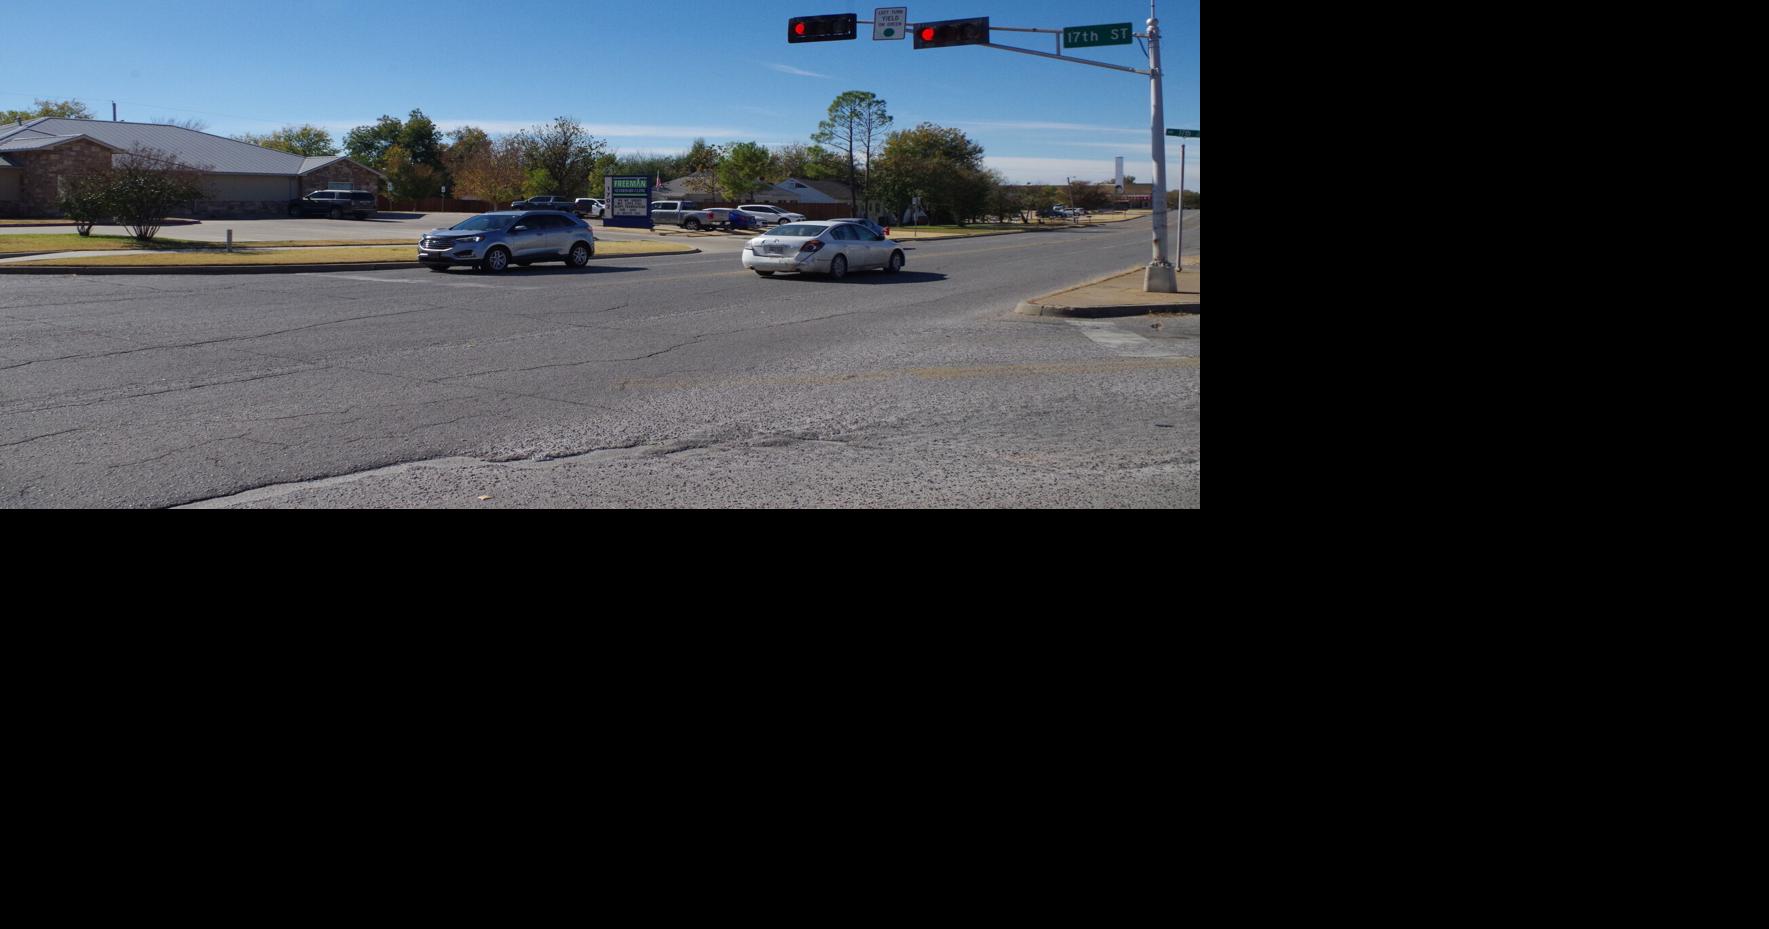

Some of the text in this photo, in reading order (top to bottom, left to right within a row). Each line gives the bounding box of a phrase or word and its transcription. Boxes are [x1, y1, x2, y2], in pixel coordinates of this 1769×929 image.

[1067, 27, 1129, 43] 17th ST
[614, 179, 646, 188] FREEMAN
